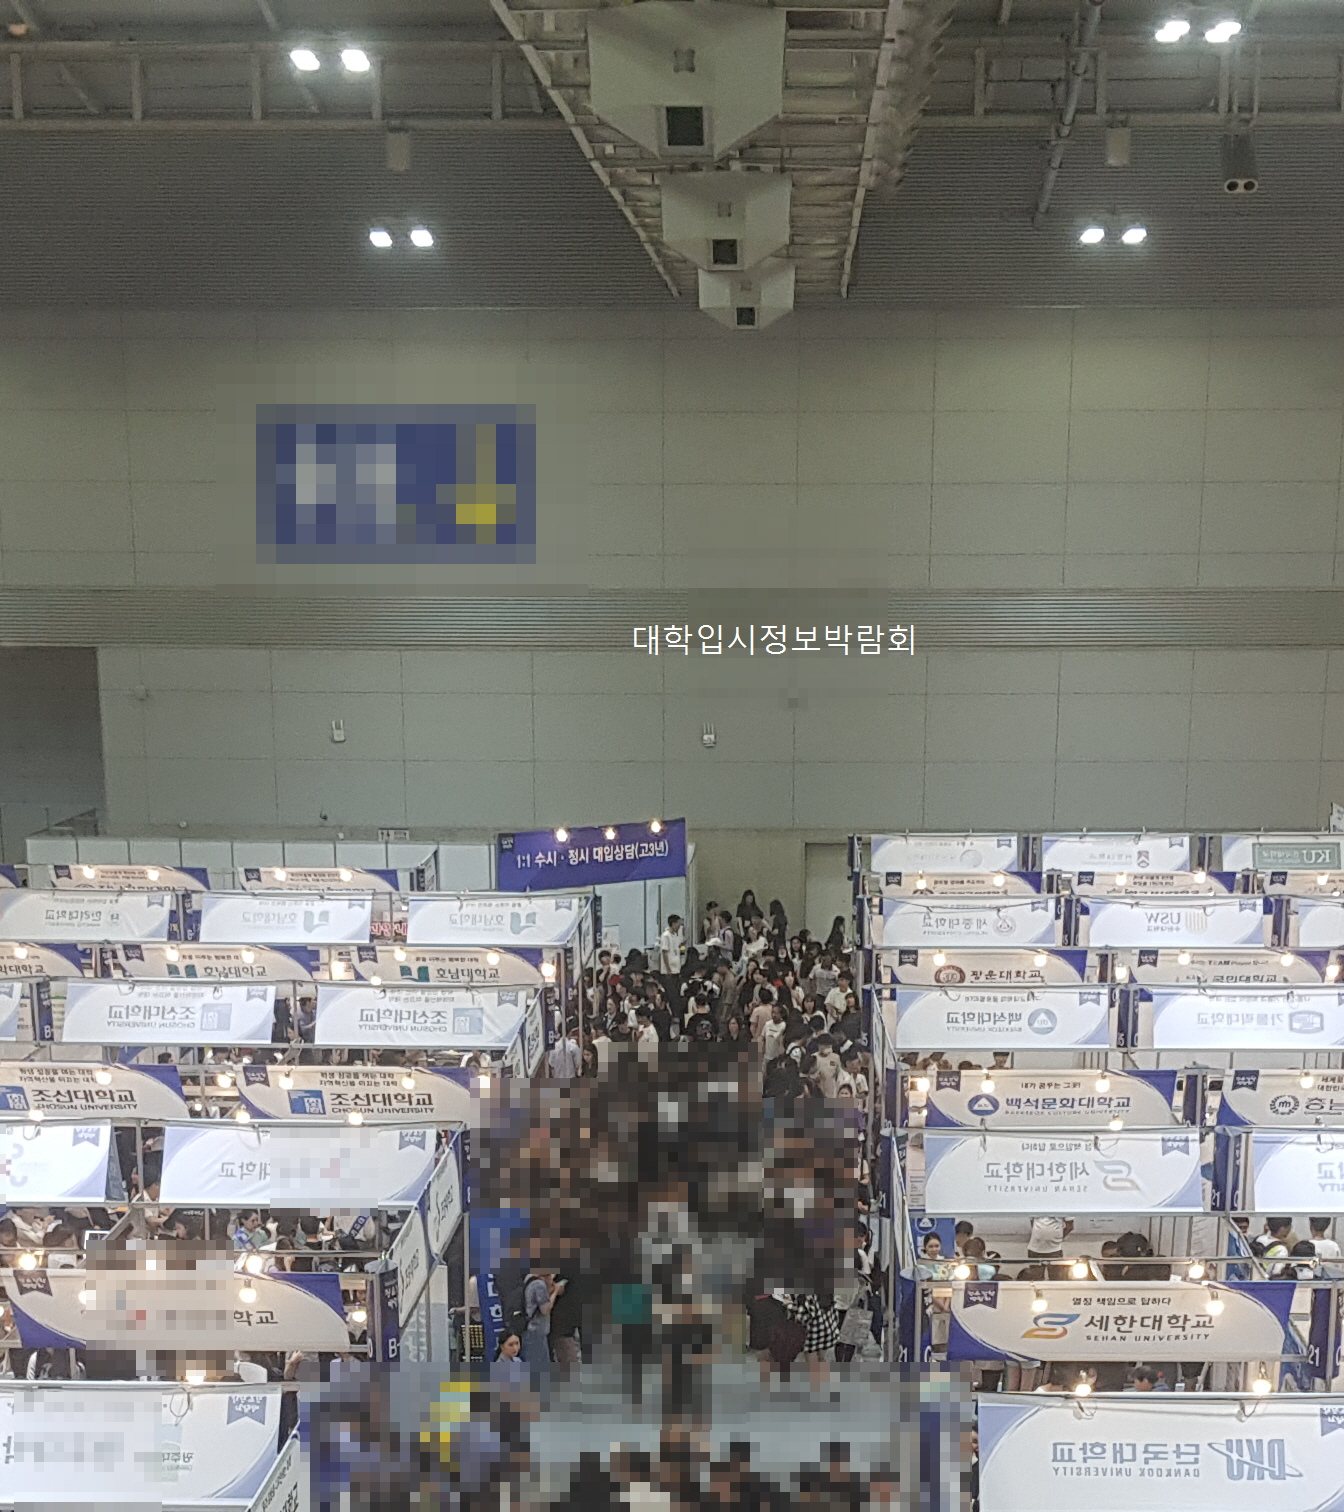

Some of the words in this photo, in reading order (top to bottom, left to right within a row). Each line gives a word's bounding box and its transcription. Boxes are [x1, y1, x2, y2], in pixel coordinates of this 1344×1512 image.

[516, 854, 532, 869] 1:1
[534, 852, 557, 868] 수시
[568, 847, 590, 865] 정시
[203, 965, 268, 978] 호남대학교
[435, 966, 501, 980] 호남대학교
[31, 1089, 137, 1105] 조선대학교
[330, 1092, 435, 1108] 조선대학교
[1005, 1095, 1132, 1111] 백석문화대학교
[80, 1103, 138, 1111] UNIVERSITY
[377, 1107, 435, 1115] UNIVERSITY
[1071, 1296, 1093, 1307] 열정
[1096, 1296, 1137, 1307] 책임으로
[1140, 1296, 1172, 1307] 답하다
[1084, 1313, 1216, 1333] 세한대학교
[1085, 1333, 1127, 1343] SEHAN
[1135, 1332, 1210, 1343] UNIVERSITY
